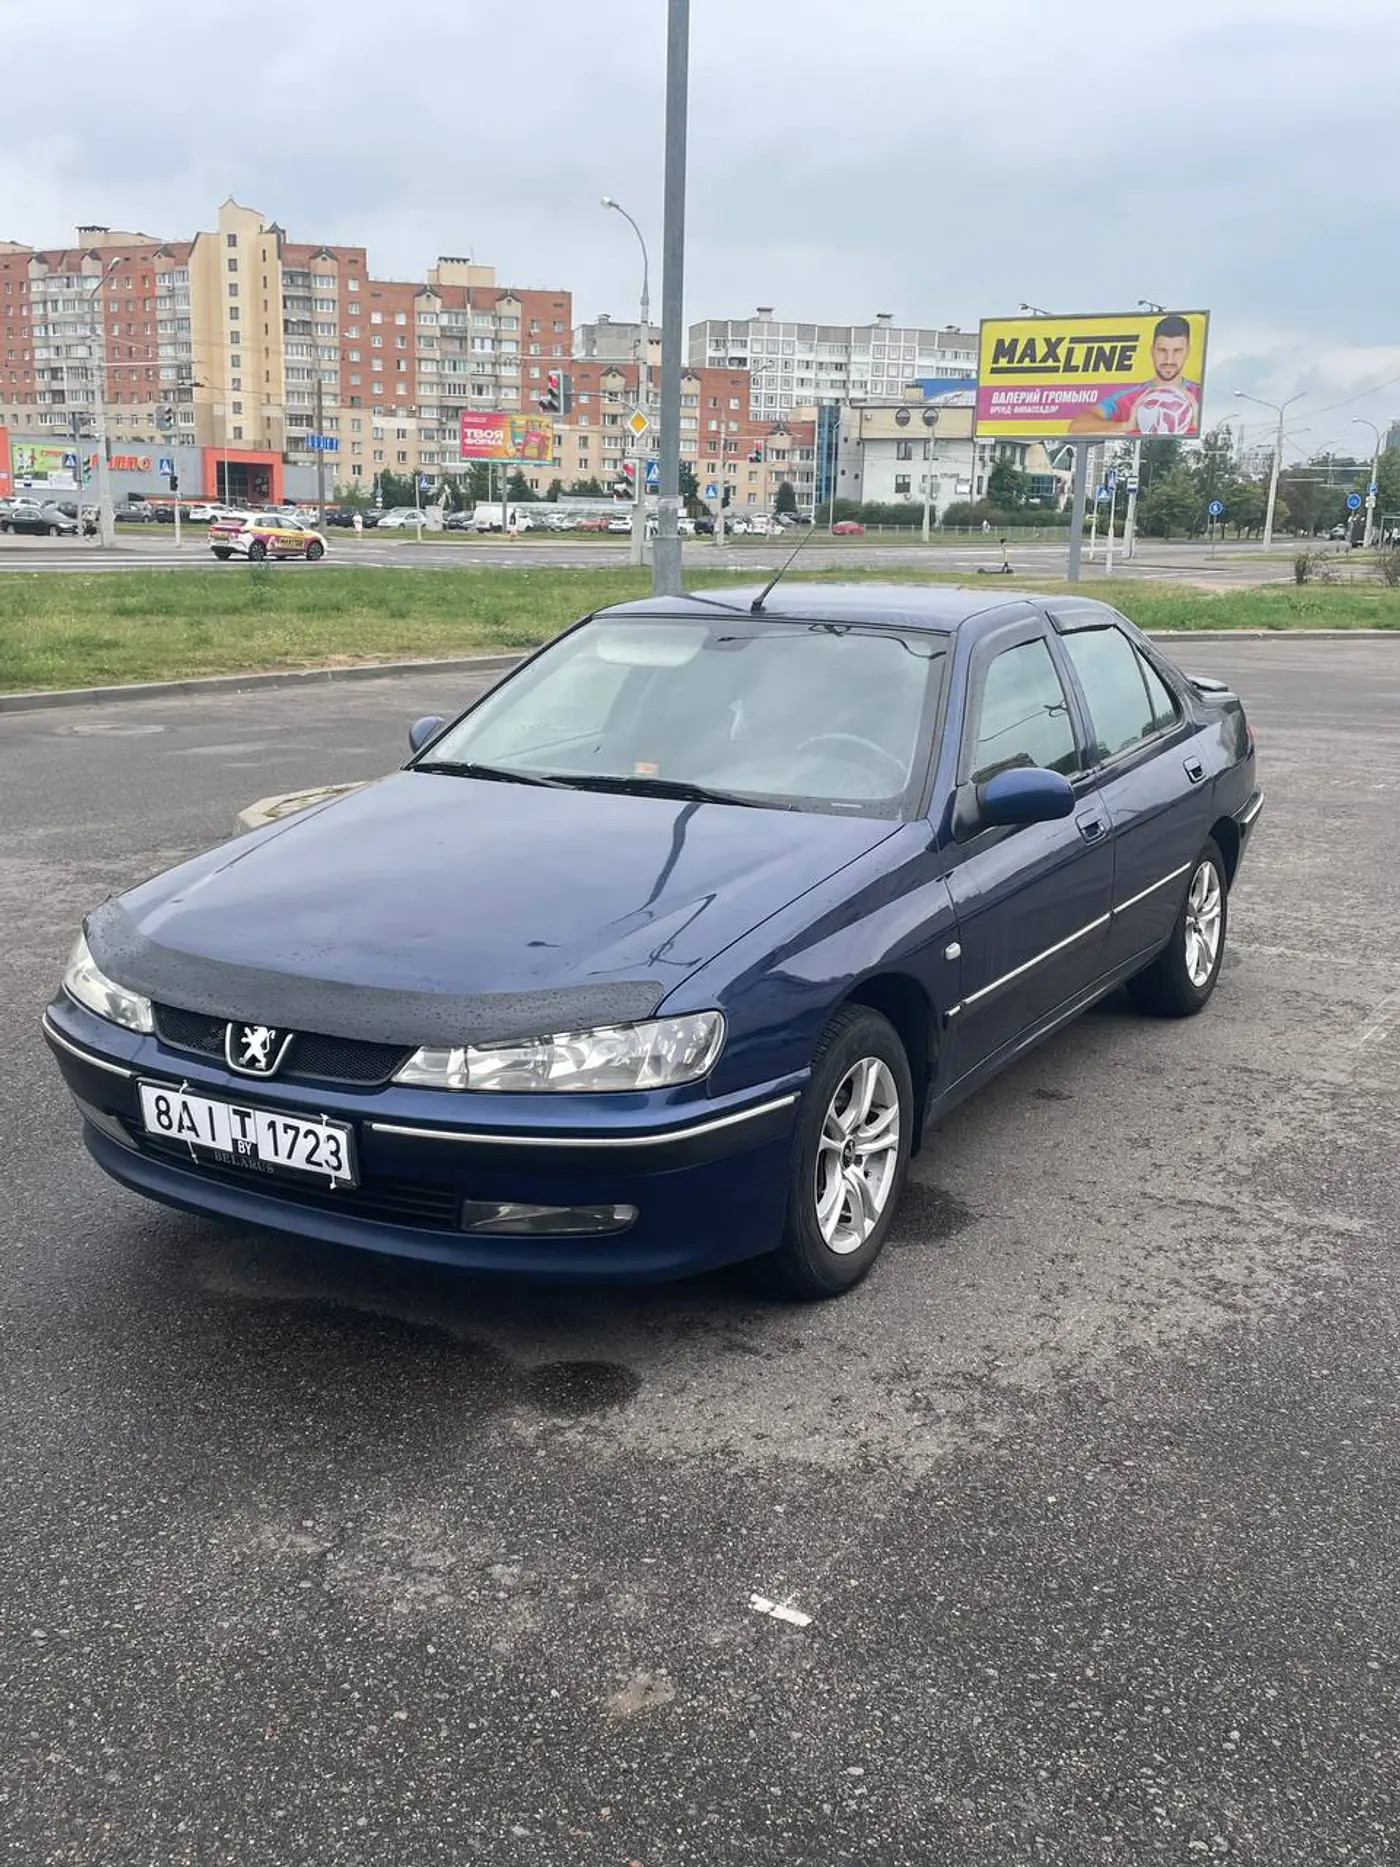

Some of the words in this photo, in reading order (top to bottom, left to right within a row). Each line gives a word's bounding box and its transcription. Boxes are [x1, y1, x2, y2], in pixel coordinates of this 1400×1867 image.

[991, 388, 1041, 404] ВАЛЕРИЙ
[1042, 390, 1098, 404] ГРОМЫКО
[463, 428, 504, 440] ТВОЯ
[463, 437, 504, 446] ФОРМА
[237, 1140, 252, 1156] BY
[214, 1151, 275, 1174] BELARUS
